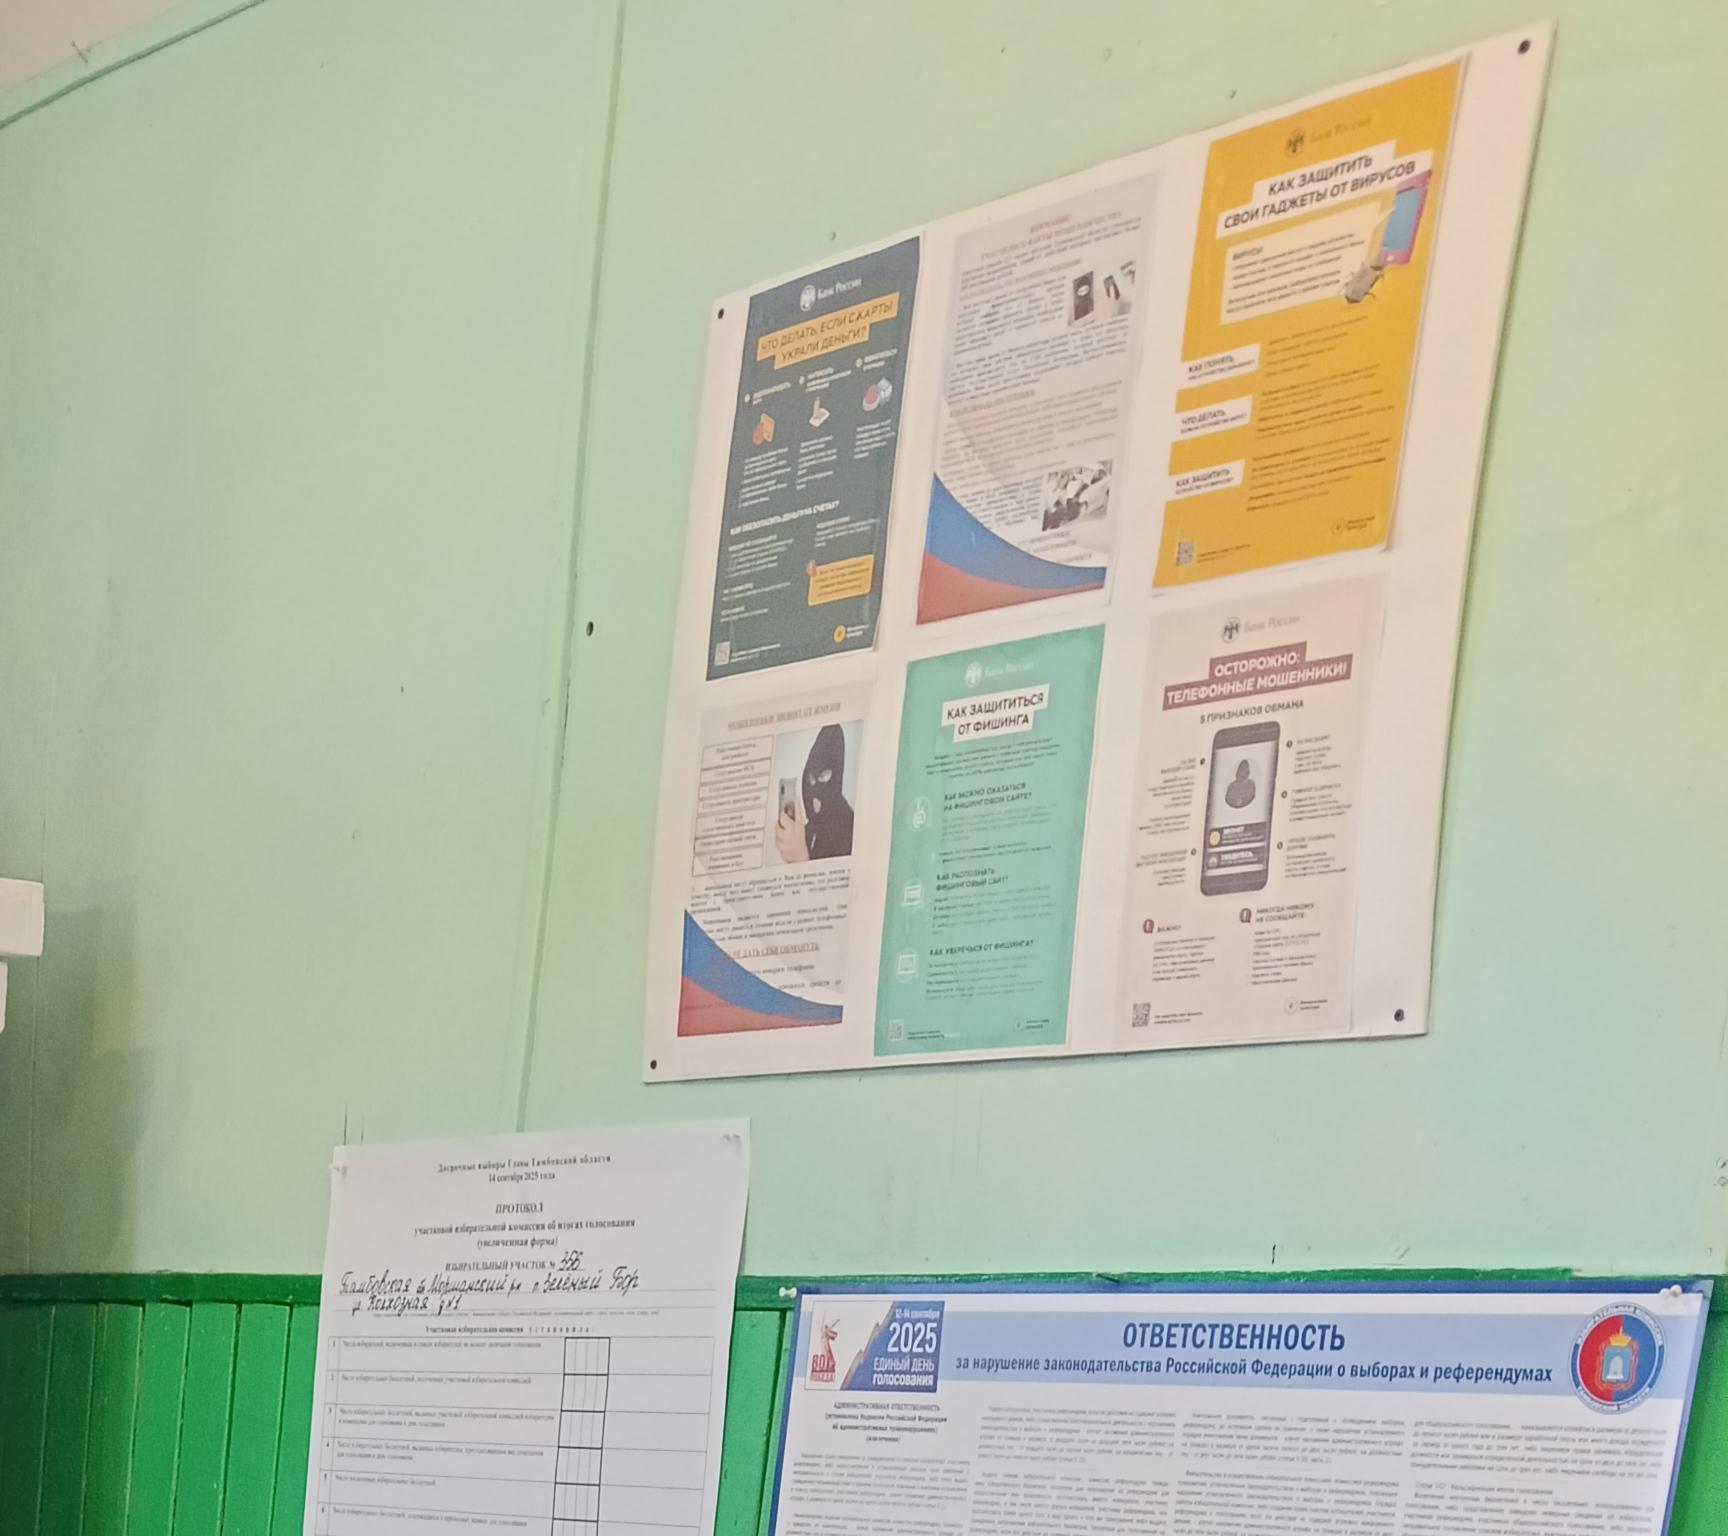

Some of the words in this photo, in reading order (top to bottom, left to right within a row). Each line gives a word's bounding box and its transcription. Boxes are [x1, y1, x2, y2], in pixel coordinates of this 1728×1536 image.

[1268, 176, 1295, 196] КАК
[1297, 154, 1373, 188] ЗАЩИТИТЬ
[1223, 208, 1259, 229] СВОИ
[1261, 189, 1327, 219] ГАДЖЕТЫ
[1330, 181, 1348, 198] ОТ
[1350, 160, 1415, 192] ВИРУСОВ
[817, 286, 834, 300] Банк
[761, 338, 779, 351] ЧТО
[820, 315, 847, 333] ЕСЛИ
[780, 341, 819, 362] УКРАЛИ
[821, 325, 867, 350] ДЕНЬГИ?
[1245, 620, 1266, 633] Банк
[1214, 652, 1301, 677] ОСТОРОЖНО:
[1166, 678, 1254, 705] ТЕЛЕФОННЫЕ
[1257, 662, 1348, 690] МОШЕННИКИ!
[947, 706, 967, 720] КАК
[969, 693, 1044, 716] ЗАЩИТИТЬСЯ
[1200, 714, 1205, 724] 5
[1207, 706, 1263, 723] ПРИЗНАКОВ
[1265, 699, 1304, 714] ОБМАНА
[958, 723, 971, 735] ОТ
[973, 714, 1029, 732] ФИШИНГА
[532, 1156, 578, 1167] Тамбовской
[580, 1154, 611, 1164] области
[489, 1173, 496, 1182] 14
[524, 1172, 539, 1181] 2025
[495, 1202, 543, 1214] ПРОТОКОЛ
[547, 1220, 556, 1230] об
[585, 1219, 635, 1229] голосования
[609, 1266, 639, 1296] Бор
[887, 1322, 938, 1353] 2025
[1122, 1322, 1346, 1351] ОТВЕТСТВЕННОСТЬ
[874, 1356, 910, 1372] ЕДИНЫЙ
[911, 1358, 935, 1373] ДЕНЬ
[955, 1357, 969, 1369] за
[972, 1357, 1040, 1373] нарушение
[1043, 1358, 1161, 1374] законодательства
[1165, 1357, 1247, 1375] Российской
[1251, 1358, 1333, 1379] Федерации
[1337, 1366, 1345, 1377] о
[1350, 1361, 1415, 1382] выборах
[1420, 1366, 1429, 1379] и
[1433, 1363, 1553, 1385] референдумах
